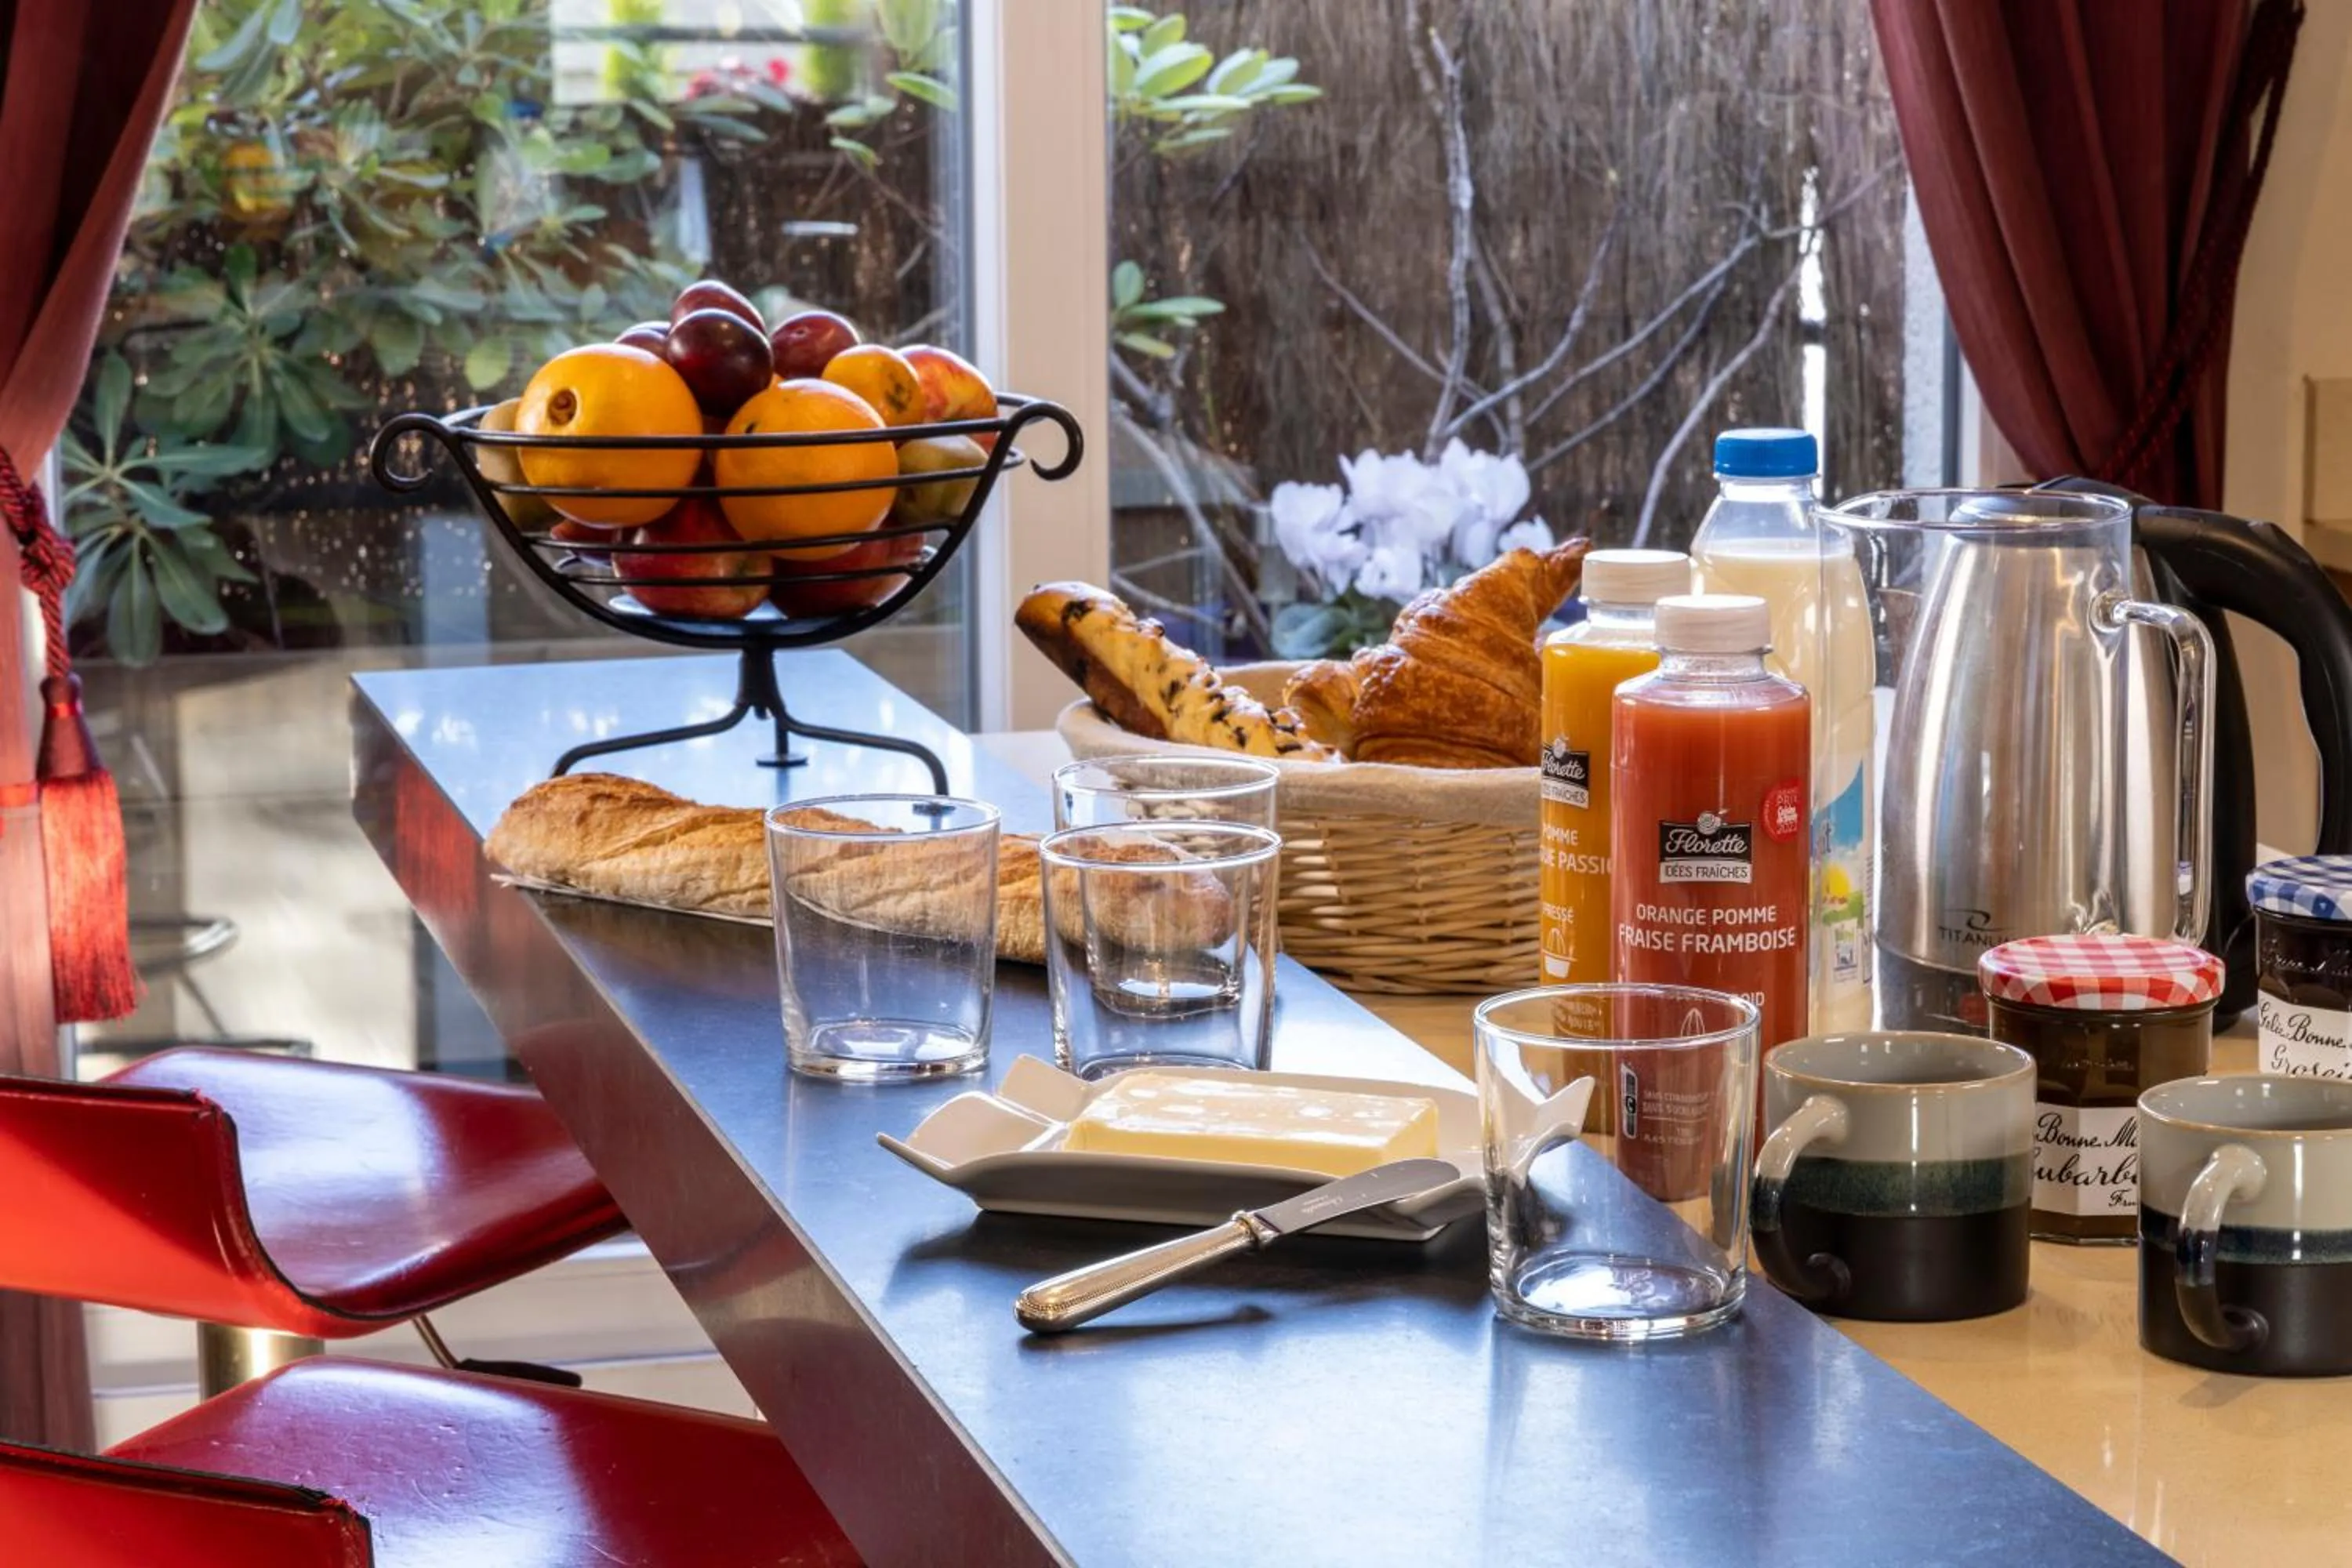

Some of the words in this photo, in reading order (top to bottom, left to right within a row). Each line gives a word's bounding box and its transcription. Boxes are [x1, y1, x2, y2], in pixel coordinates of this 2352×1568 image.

[1665, 829, 1748, 854] Florette
[1664, 863, 1693, 878] IDÉES
[1696, 863, 1748, 879] FRAÎCHES
[1636, 903, 1706, 925] ORANGE
[1712, 906, 1777, 925] POMME
[1619, 923, 1675, 952] FRAISE
[1682, 926, 1797, 954] FRAMBOISE
[2288, 1013, 2346, 1049] Bonne
[2036, 1112, 2102, 1148] Bonne
